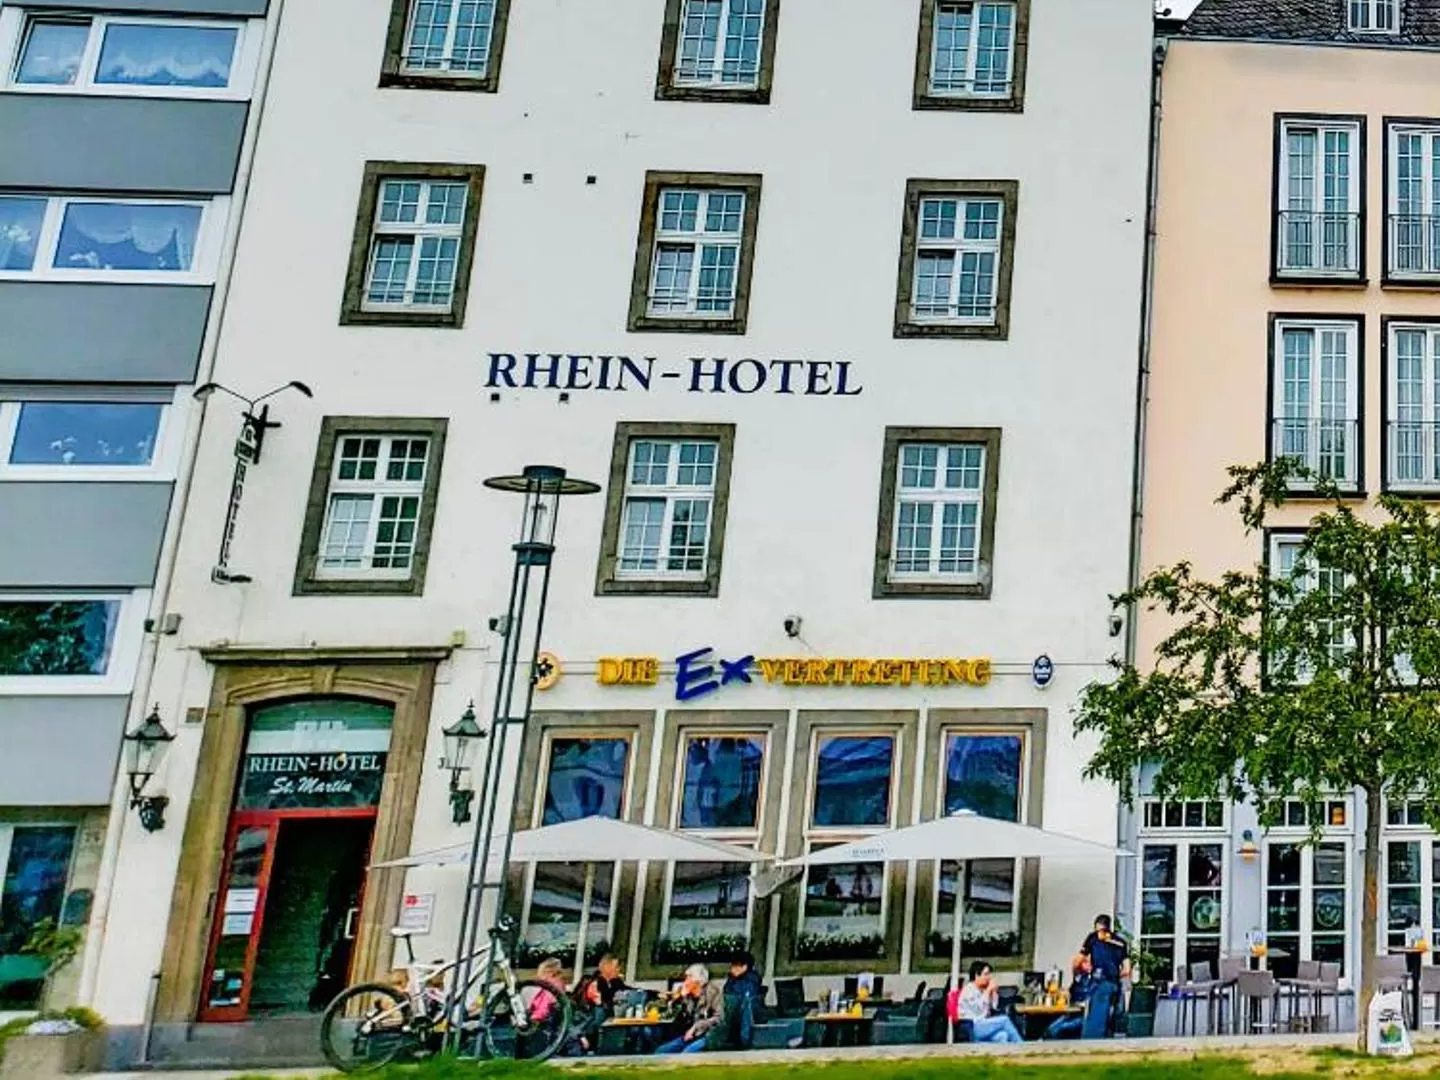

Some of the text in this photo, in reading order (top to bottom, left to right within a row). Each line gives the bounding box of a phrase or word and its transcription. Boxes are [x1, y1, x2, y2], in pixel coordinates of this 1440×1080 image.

[484, 352, 863, 396] RHEIN-HOTEL
[597, 655, 659, 685] DIE
[249, 754, 381, 772] RHEIN-HOTEL
[269, 776, 353, 794] St. Martin
